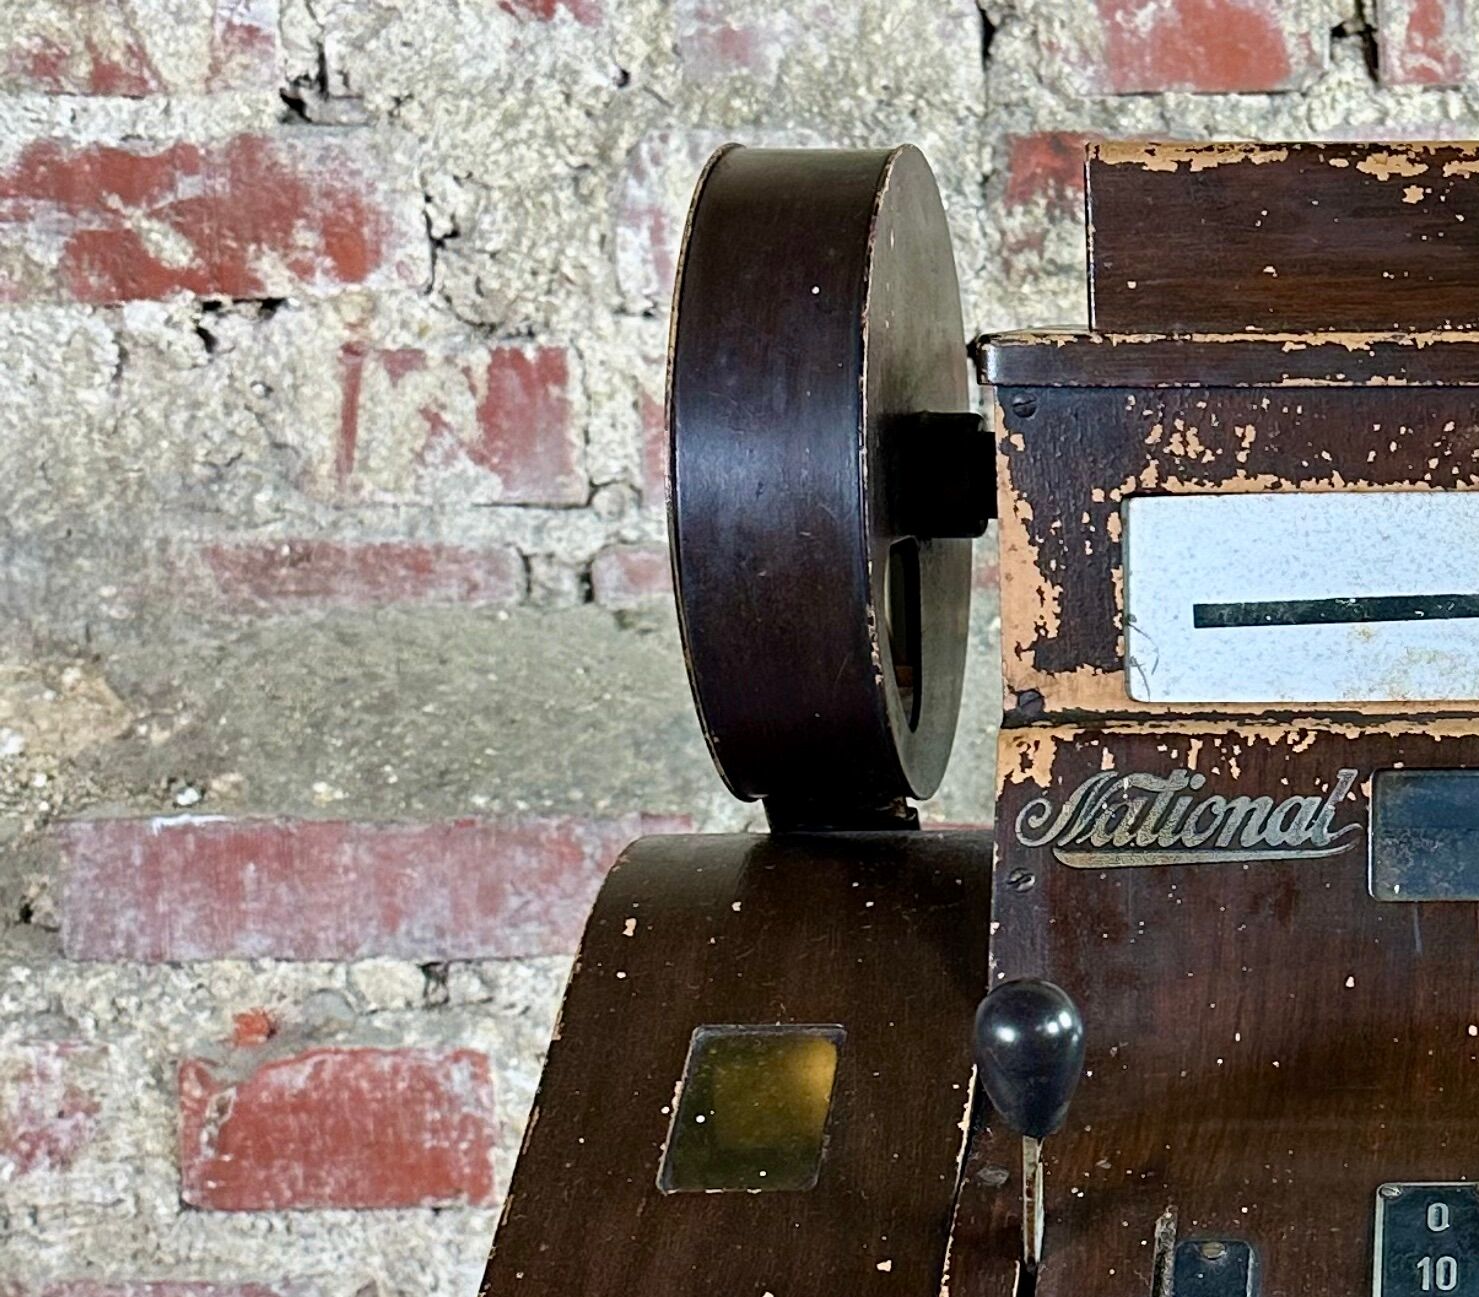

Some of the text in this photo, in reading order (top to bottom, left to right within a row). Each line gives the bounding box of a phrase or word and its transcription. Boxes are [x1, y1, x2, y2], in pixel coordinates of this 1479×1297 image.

[1015, 768, 1364, 850] National
[1427, 1203, 1449, 1231] 0
[1416, 1256, 1458, 1290] 10
